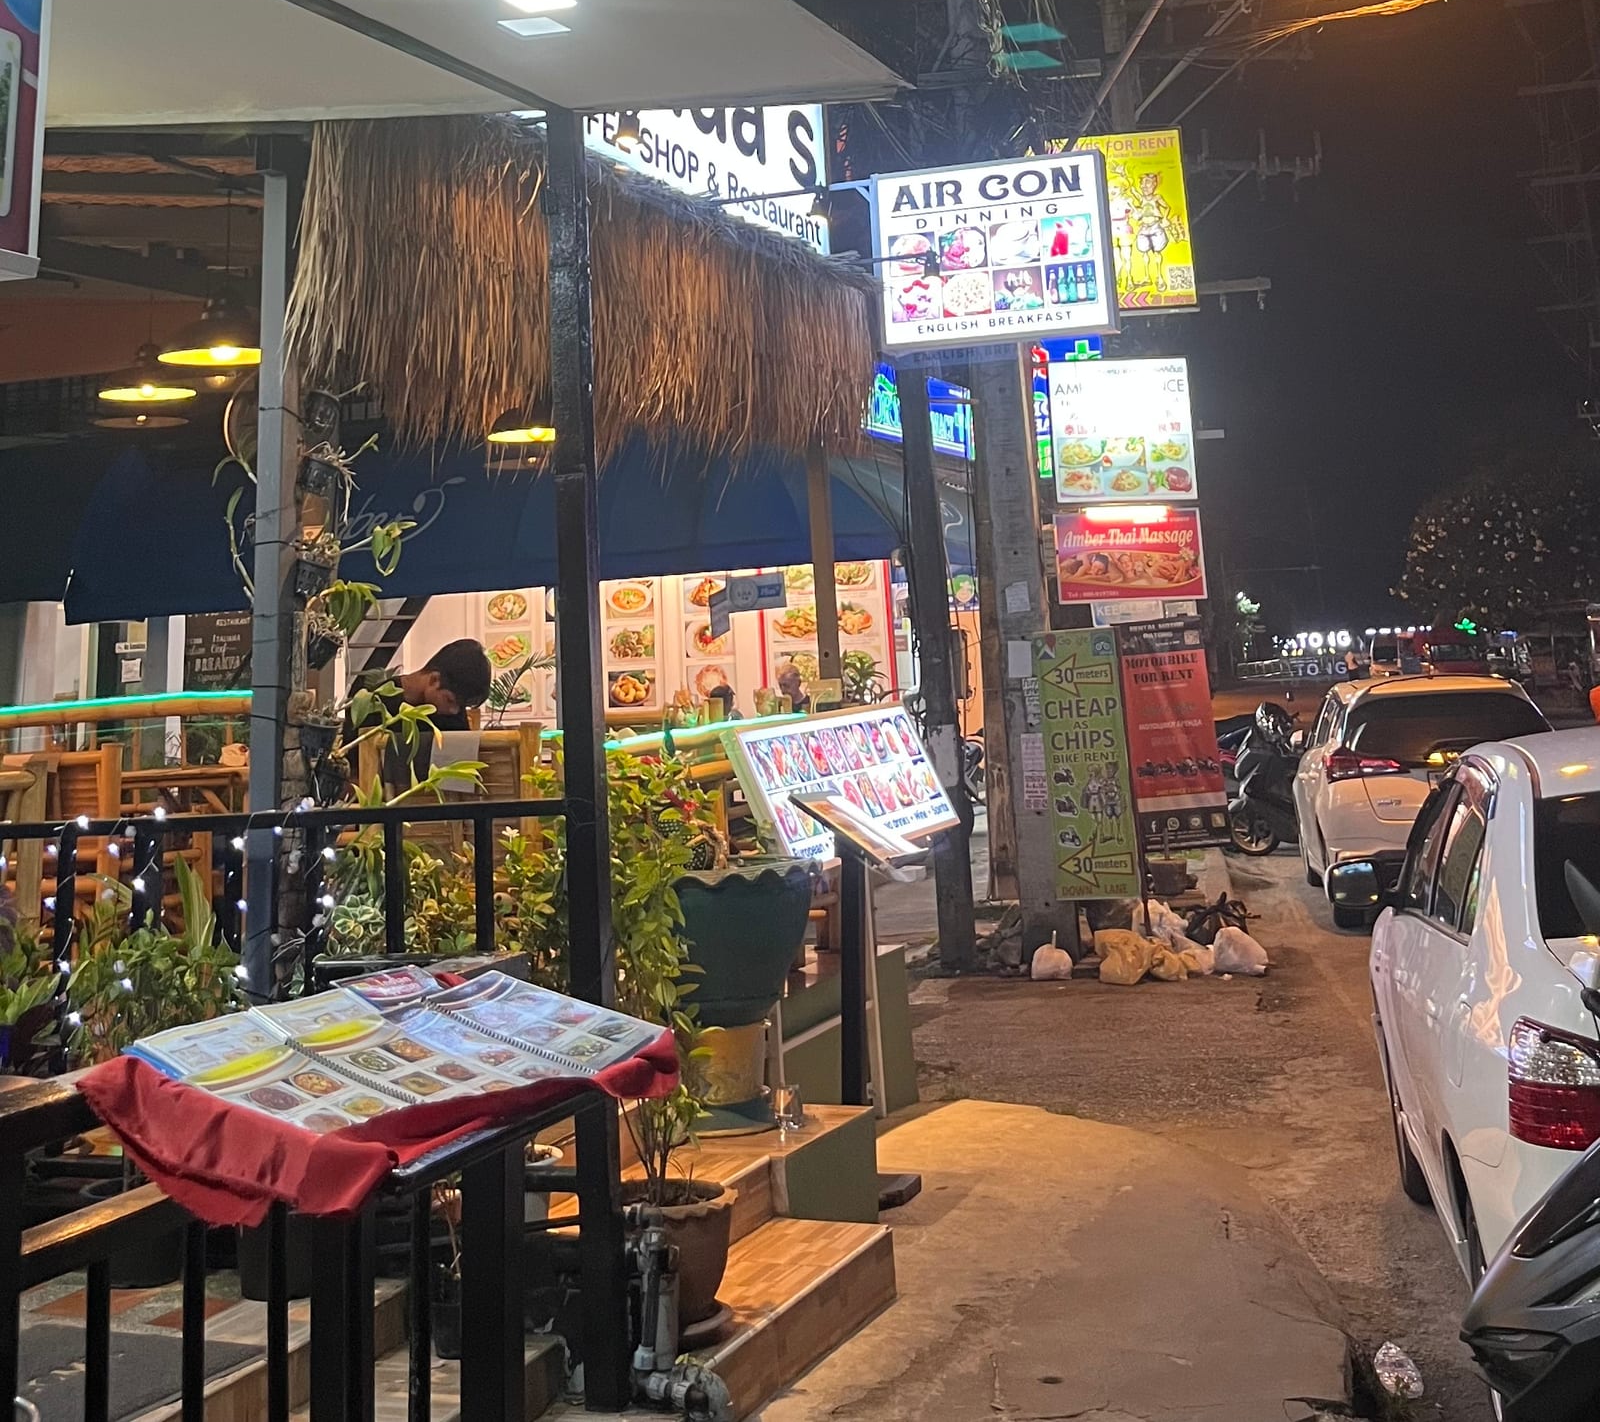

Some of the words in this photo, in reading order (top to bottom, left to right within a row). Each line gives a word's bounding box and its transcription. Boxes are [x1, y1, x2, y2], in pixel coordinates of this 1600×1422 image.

[1106, 139, 1134, 152] FOR
[1139, 136, 1176, 150] RENT
[639, 127, 699, 183] SHOP
[707, 161, 721, 198] &
[727, 171, 822, 246] Restaurant
[891, 179, 963, 213] AIR
[978, 164, 1082, 201] CON
[916, 203, 1058, 230] DINNING
[918, 319, 979, 335] ENGLISH
[989, 310, 1073, 328] BREAKFAST
[1063, 529, 1106, 548] Amber
[1106, 527, 1137, 546] Thai
[1138, 527, 1194, 547] Massage
[1125, 652, 1199, 670] MOTORBIKE
[1055, 667, 1074, 685] 30
[1076, 665, 1109, 679] meters
[1133, 672, 1158, 685] FOR
[1160, 668, 1195, 682] RENT
[1044, 697, 1118, 720] CHEAP
[1073, 720, 1089, 730] AS
[1051, 729, 1116, 751] CHIPS
[1053, 752, 1080, 764] BIKE
[1084, 751, 1117, 763] RENT
[1072, 856, 1093, 874] 30
[1094, 856, 1128, 870] meters
[1061, 884, 1094, 897] DOWN
[1104, 882, 1129, 894] LANE
